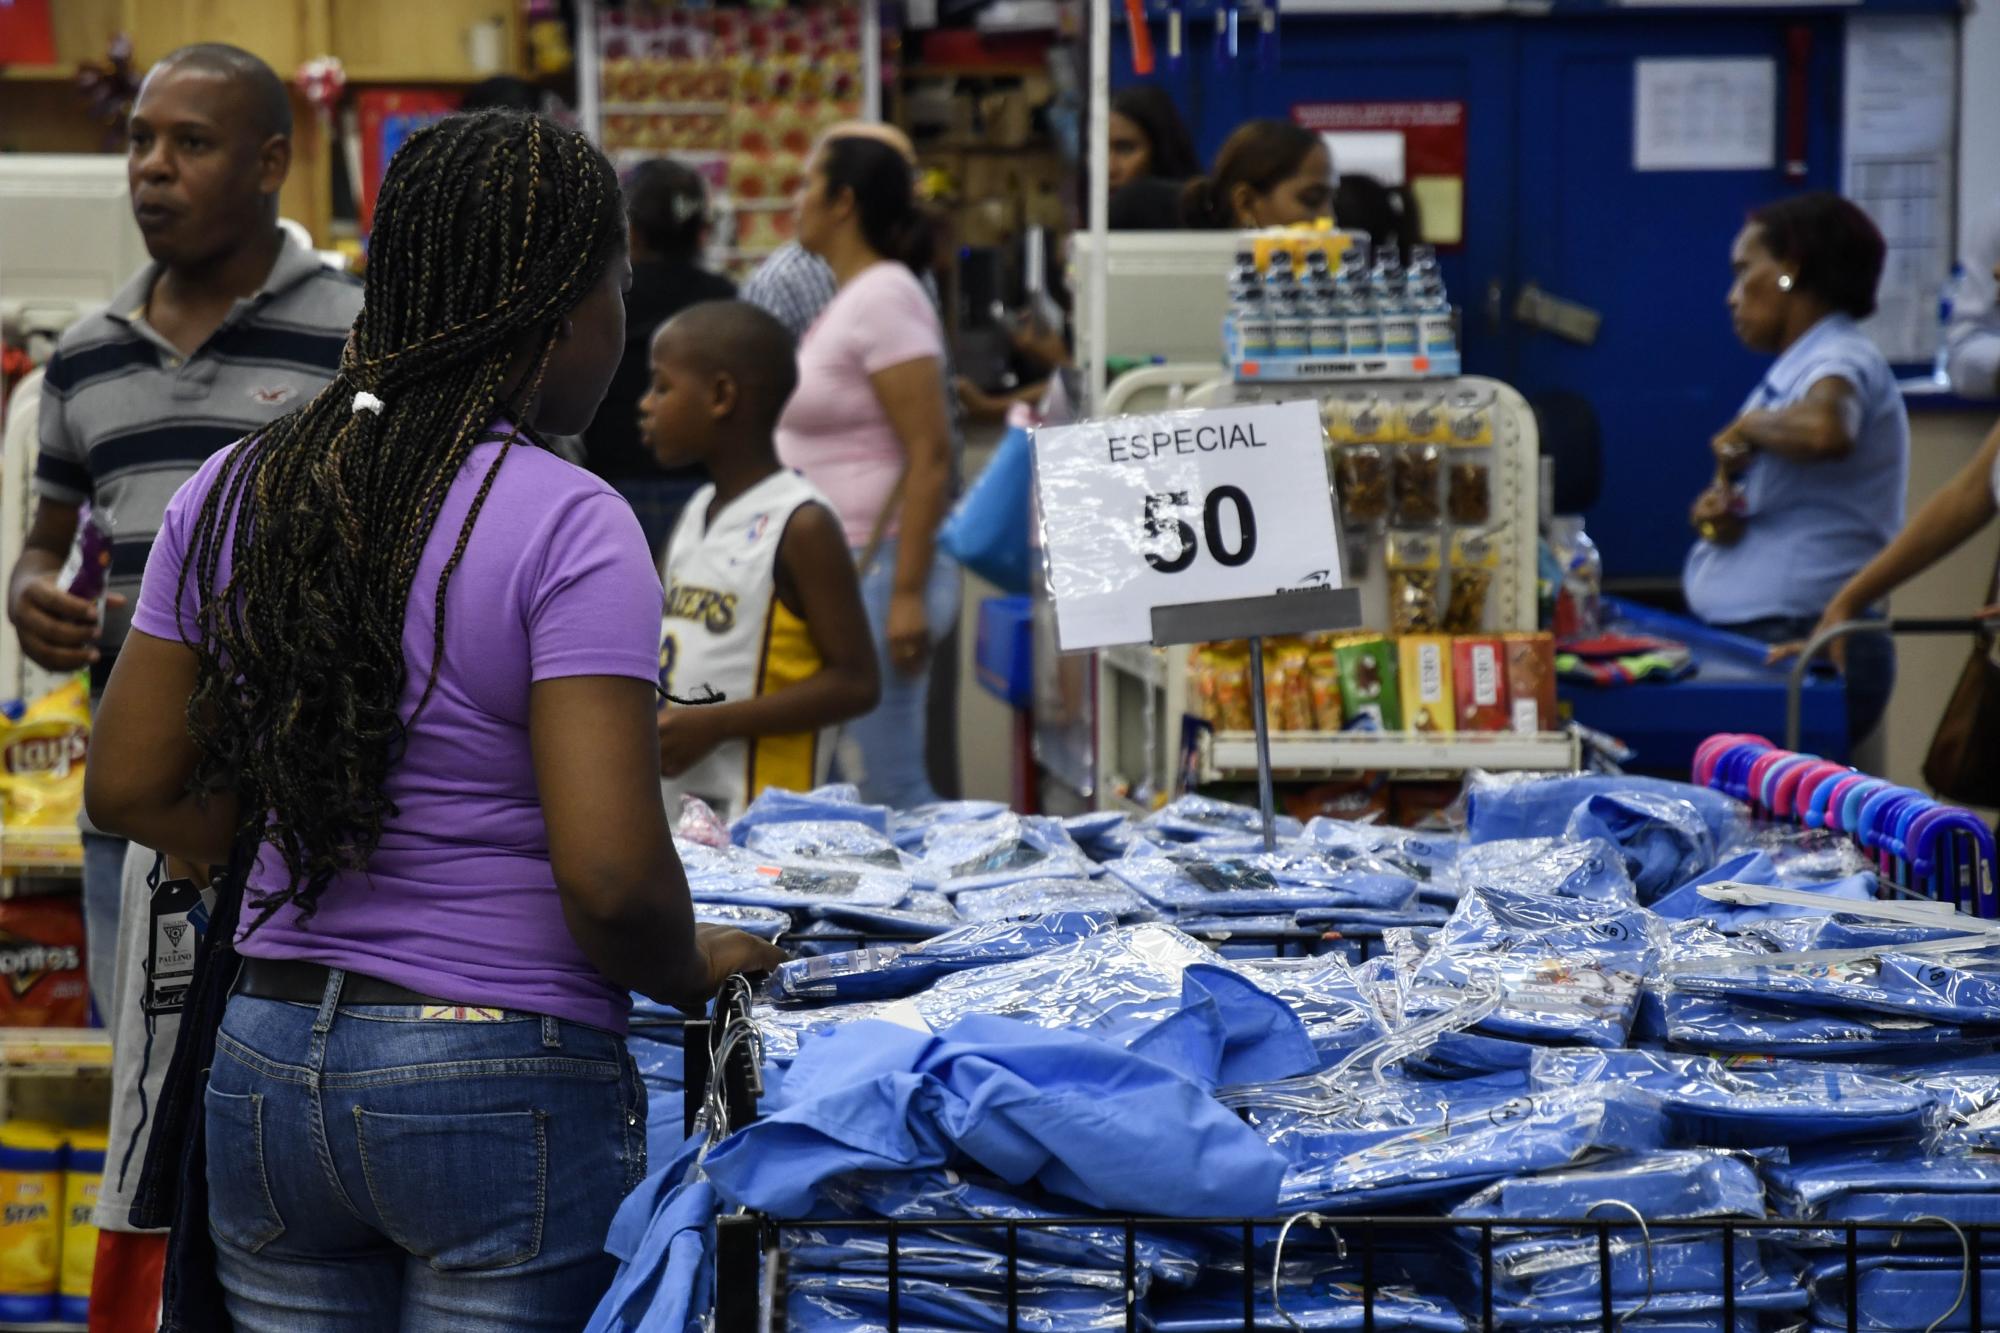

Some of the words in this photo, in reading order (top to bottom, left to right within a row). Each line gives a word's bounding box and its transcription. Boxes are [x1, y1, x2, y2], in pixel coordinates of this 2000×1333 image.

[1108, 422, 1267, 463] ESPECIAL
[1143, 484, 1258, 574] 50
[1601, 924, 1619, 937] 18
[158, 952, 192, 964] PAULINO
